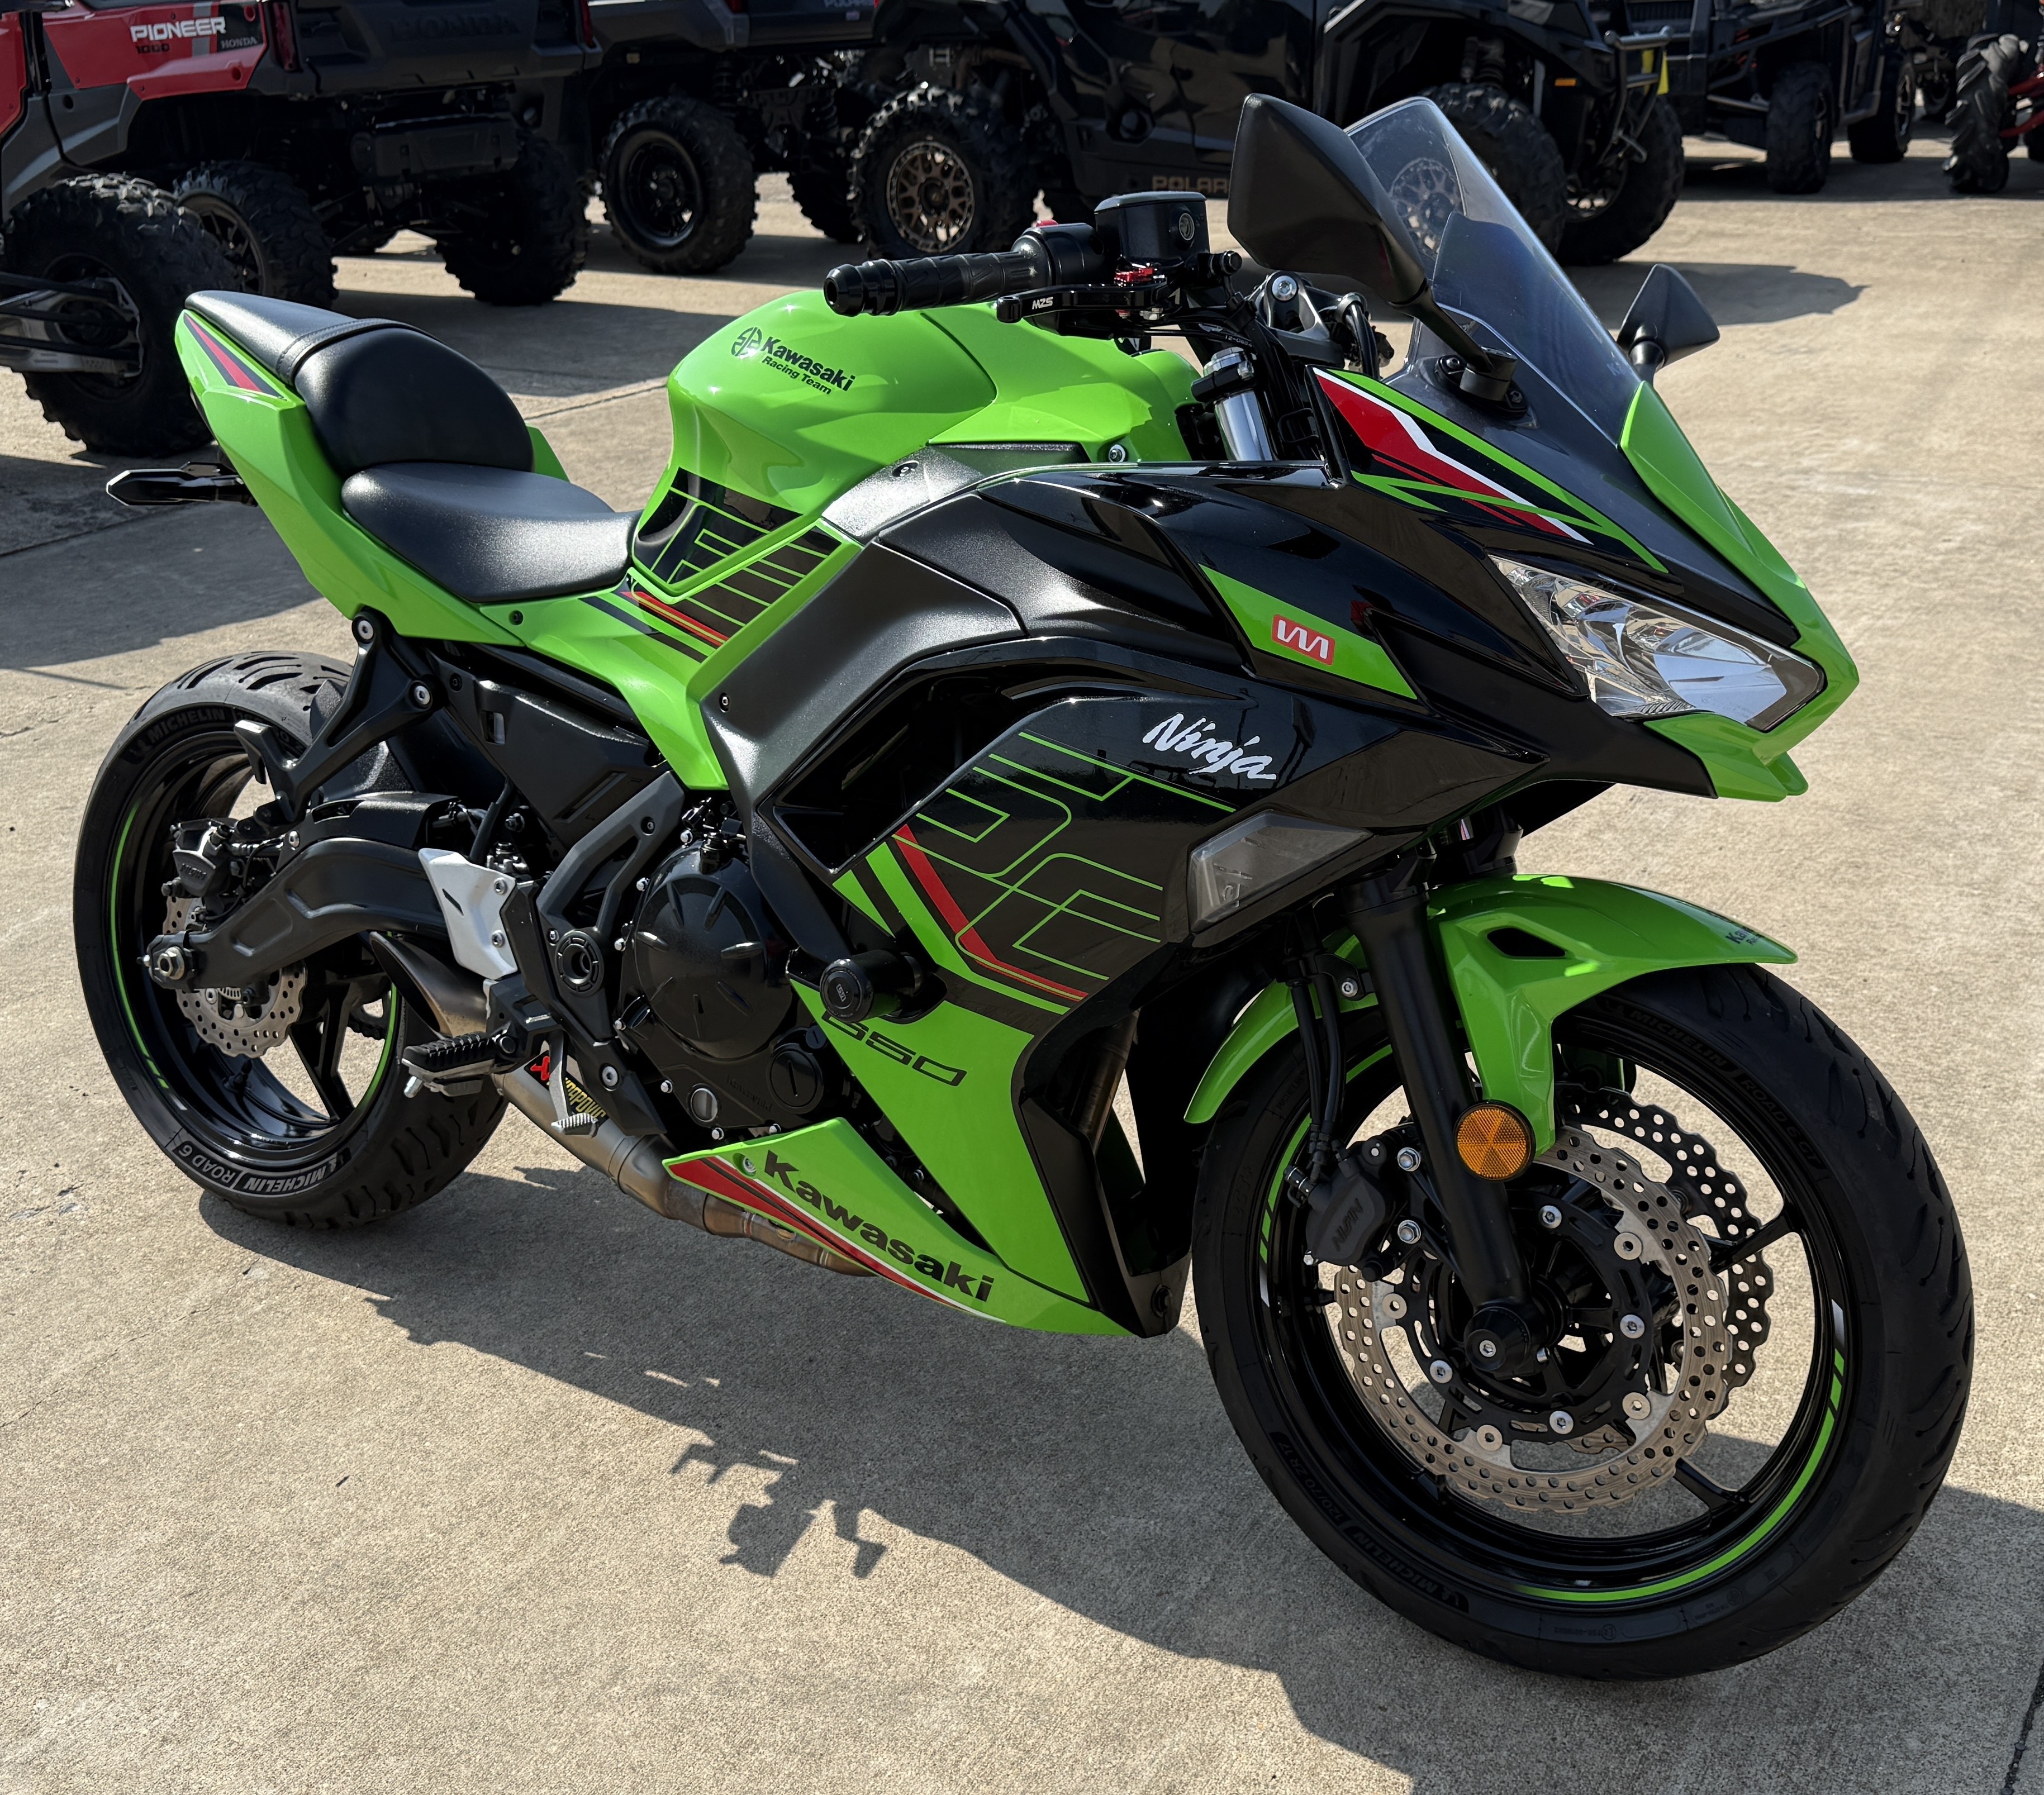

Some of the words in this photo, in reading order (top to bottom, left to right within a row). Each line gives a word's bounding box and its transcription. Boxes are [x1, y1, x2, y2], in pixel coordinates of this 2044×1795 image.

[130, 16, 226, 42] PIONEER
[221, 36, 258, 49] HONDA
[136, 44, 170, 55] 1000
[1152, 176, 1229, 194] POLAR
[760, 336, 856, 392] Kawasaki
[762, 356, 800, 379] Racing
[801, 373, 832, 394] Team
[148, 708, 226, 743] MICHELIN
[1142, 712, 1278, 780] Ninja
[822, 1011, 968, 1087] 650
[1629, 1009, 1726, 1068] MICHELIN
[1740, 1078, 1788, 1123] ROAD
[178, 1144, 193, 1157] 6
[192, 1153, 236, 1184] ROAD
[244, 1164, 329, 1192] MICHELIN
[764, 1150, 995, 1302] Kawasaki
[1290, 1458, 1308, 1476] ZR
[1304, 1479, 1342, 1522] 120/70
[1353, 1532, 1438, 1593] MICHELIN
